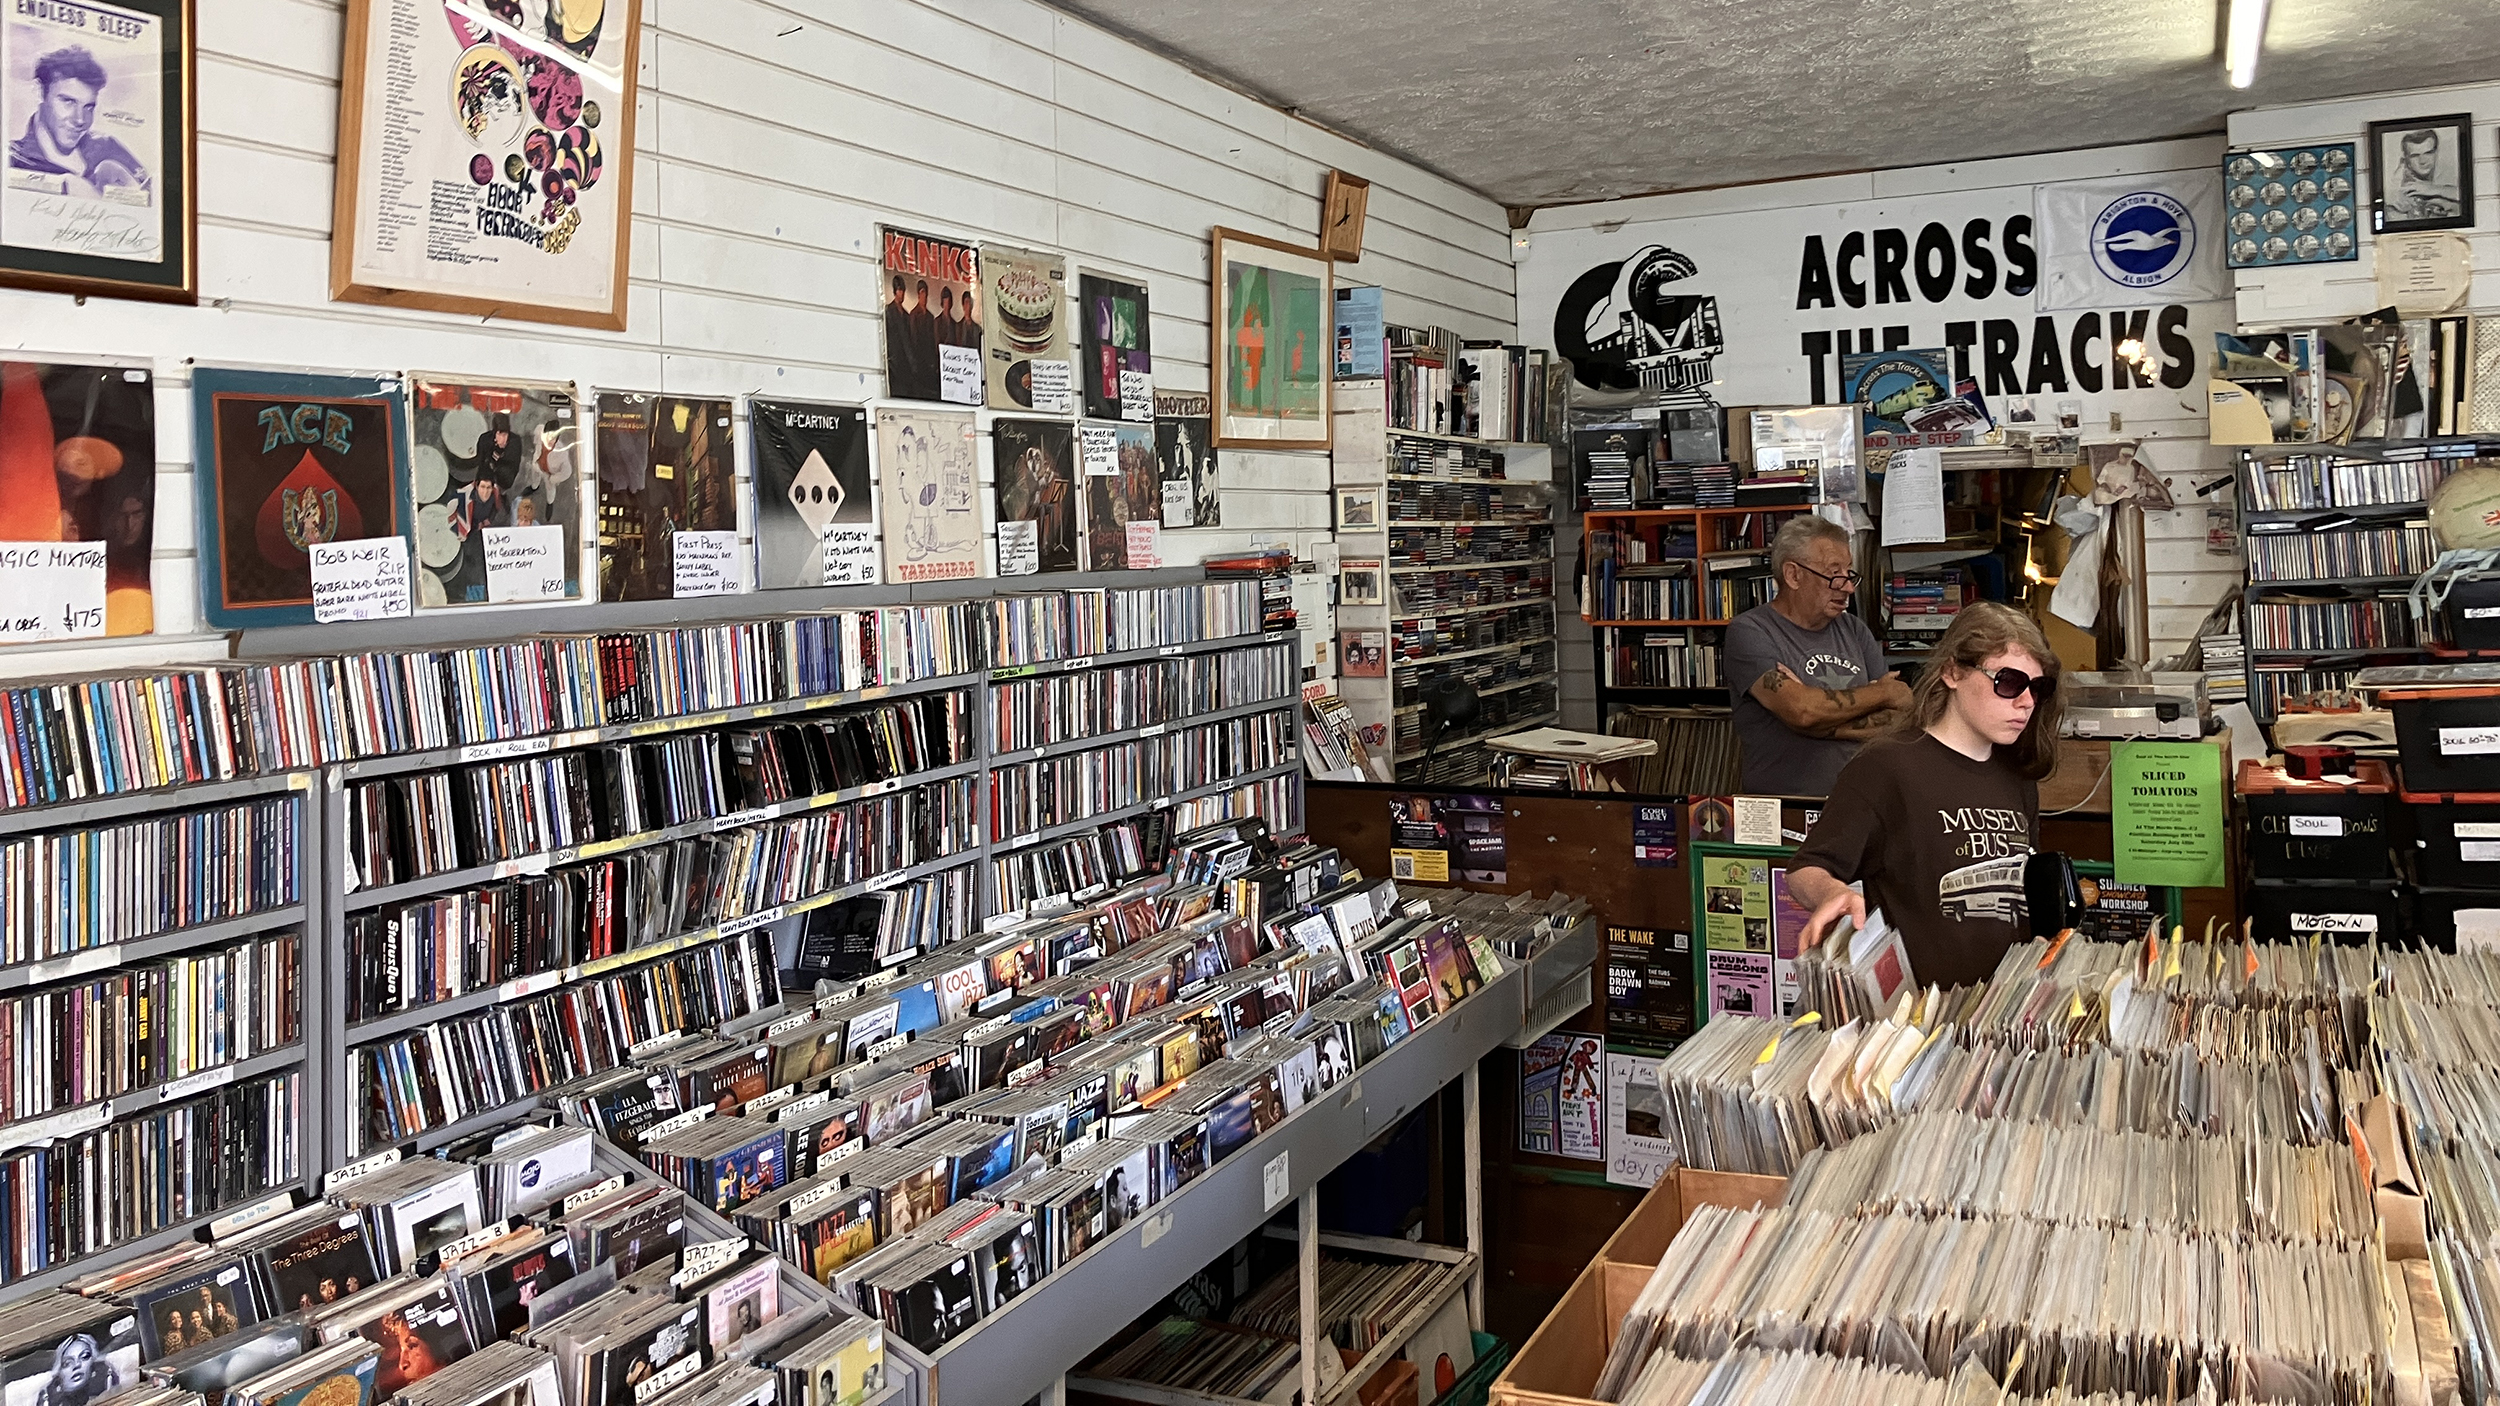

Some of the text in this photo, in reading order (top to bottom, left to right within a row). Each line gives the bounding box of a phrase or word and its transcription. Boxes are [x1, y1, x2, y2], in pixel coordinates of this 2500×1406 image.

[16, 0, 143, 40] ENDLESS SLEEP
[2101, 197, 2147, 224] BRIGHTON
[2162, 201, 2184, 217] HOVE
[884, 232, 978, 284] KINKS
[1797, 214, 2036, 310] ACROSS
[2122, 273, 2162, 284] ALBION
[1946, 305, 2195, 397] TRACKS
[1859, 362, 1924, 393] Across The Tracks
[258, 403, 353, 454] ACE
[785, 412, 840, 430] McCARTNEY
[1864, 432, 1962, 448] IND THE STEP
[488, 534, 510, 545] WHO
[677, 535, 722, 550] FIRST PRESS
[0, 549, 106, 570] AGIC MIXTURE
[315, 547, 390, 567] BOB WEIR
[499, 546, 547, 557] GENERATION
[515, 561, 533, 570] COPY
[898, 561, 975, 581] YARDBIRDS
[351, 580, 372, 590] DEAD
[379, 589, 406, 599] LABEL
[62, 602, 103, 633] £175
[318, 608, 347, 618] PROMO
[382, 599, 408, 616] £50
[1302, 683, 1327, 702] CORD
[468, 748, 490, 758] ROCK
[532, 741, 547, 749] ERA
[2142, 771, 2186, 781] SLICED
[2131, 787, 2198, 797] TOMATOES
[1807, 813, 1821, 824] CA
[1938, 808, 2029, 833] MUSEU
[2261, 816, 2287, 835] CLi
[2295, 818, 2329, 828] SOUL
[1955, 832, 2010, 858] of BUS
[1038, 894, 1062, 909] WORLD
[2100, 899, 2149, 910] WORKSHOP
[2101, 891, 2147, 900] SHOWCASE
[1351, 917, 1376, 944] ELVIS
[2296, 916, 2363, 929] MOTOWN
[1609, 928, 1655, 945] THE WAKE
[1710, 955, 1746, 965] DRUM
[1710, 963, 1768, 974] LESSONS
[946, 967, 976, 993] COOL
[1609, 968, 1636, 979] BADLY
[1609, 977, 1642, 988] DRAWN
[961, 984, 985, 1009] JAZZ
[1609, 986, 1627, 996] BOY
[170, 1070, 223, 1091] COUNTRY
[713, 1074, 740, 1092] QUINCY
[742, 1063, 763, 1080] JONES
[613, 1092, 637, 1109] ELLA
[601, 1099, 656, 1128] FITZGERALD
[797, 1127, 810, 1152] LEE
[520, 1163, 541, 1178] MOJO
[1614, 1154, 1648, 1180] day
[817, 1210, 848, 1266] JAZZ
[271, 1229, 359, 1271] The Three Degrees
